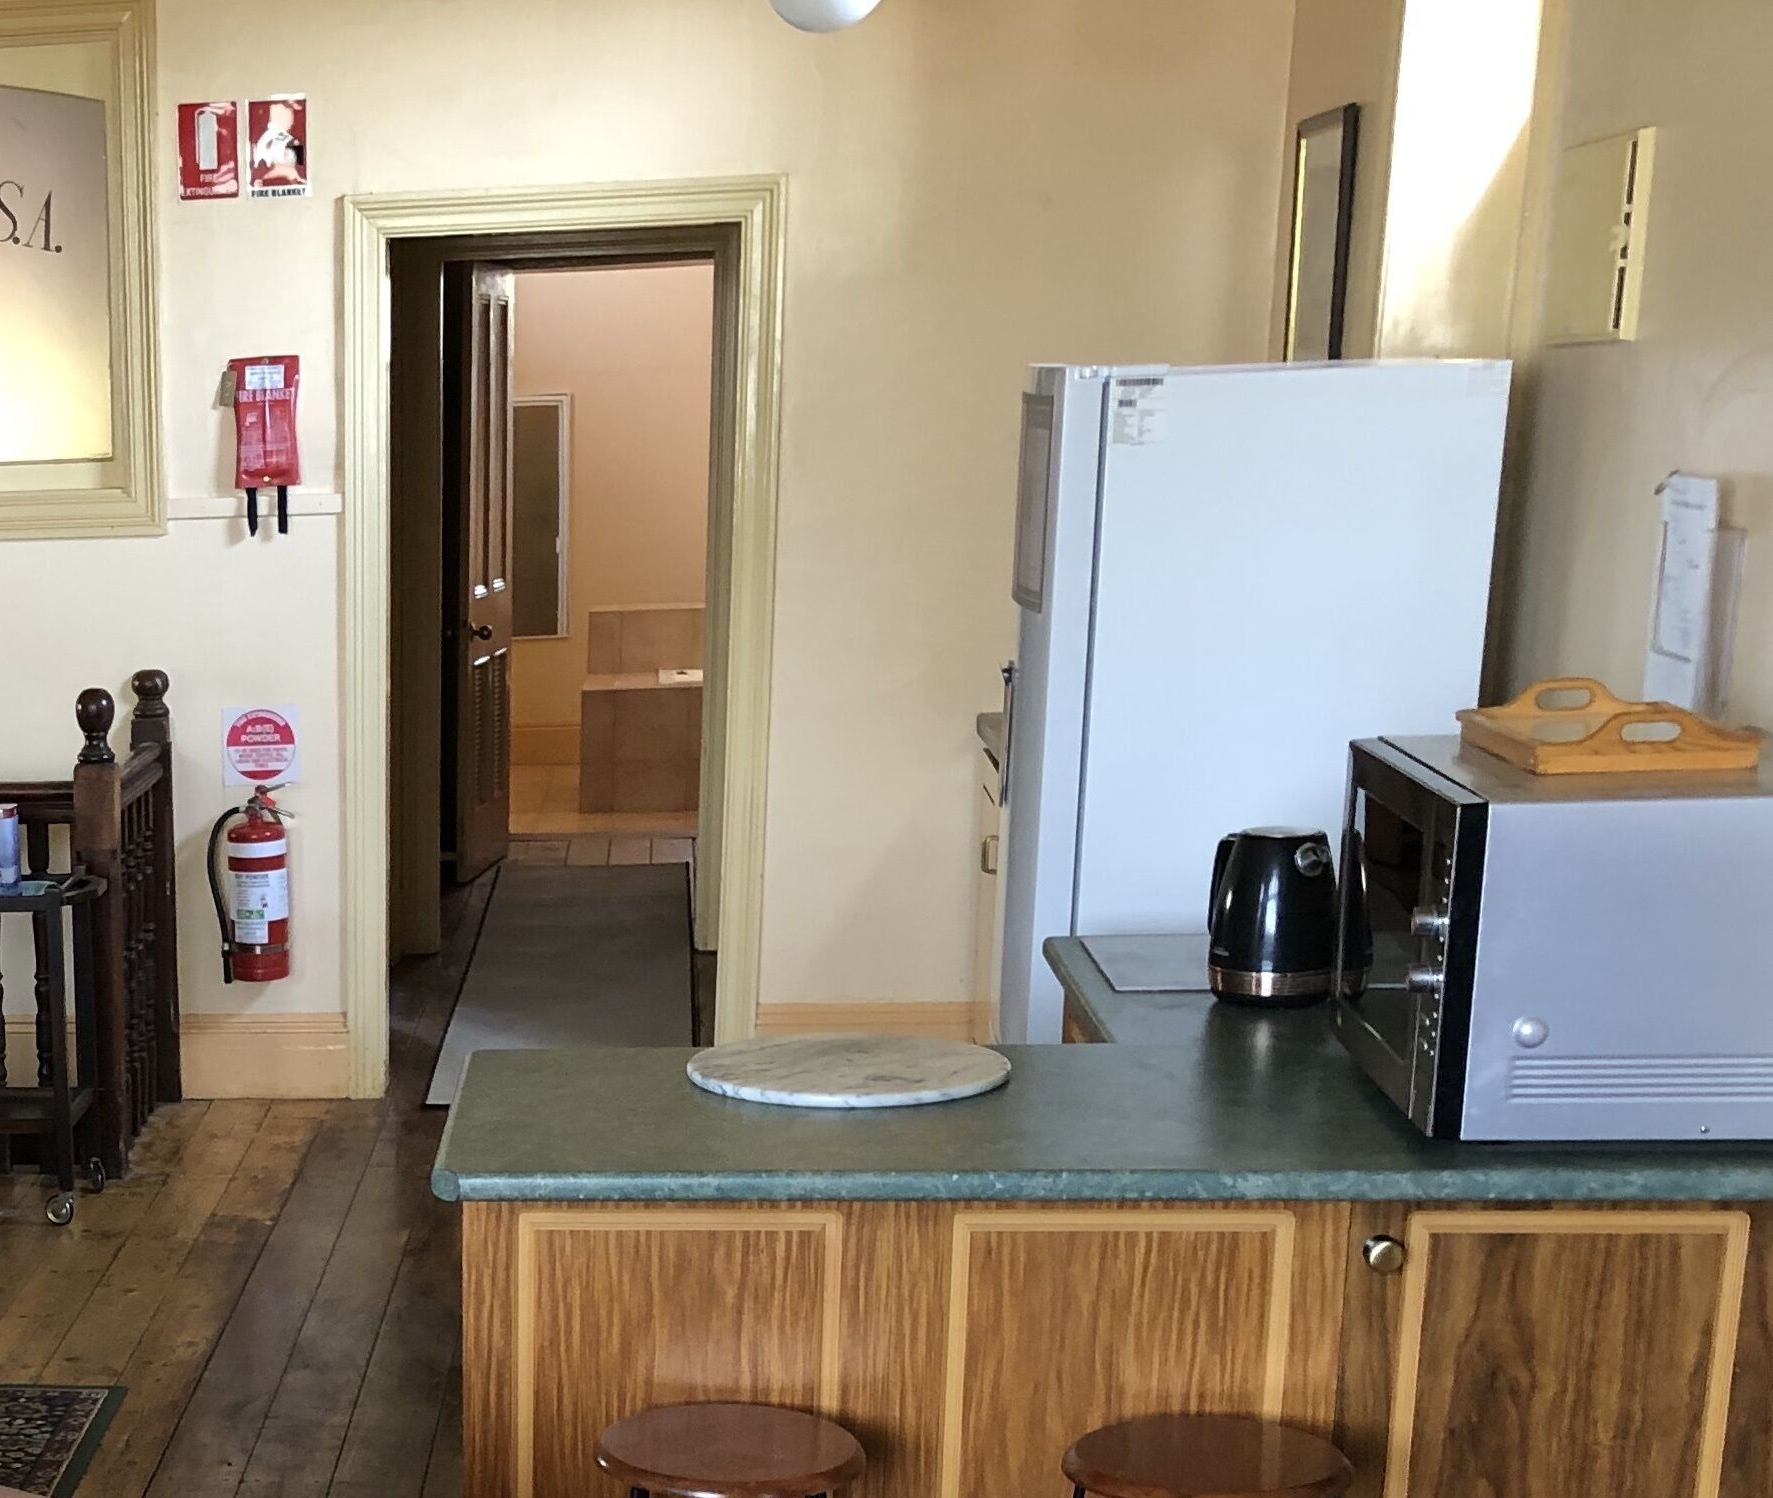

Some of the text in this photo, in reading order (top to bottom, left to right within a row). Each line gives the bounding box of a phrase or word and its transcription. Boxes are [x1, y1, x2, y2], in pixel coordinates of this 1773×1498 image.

[251, 187, 306, 198] FIRE BLANKET
[240, 733, 282, 743] POWDER
